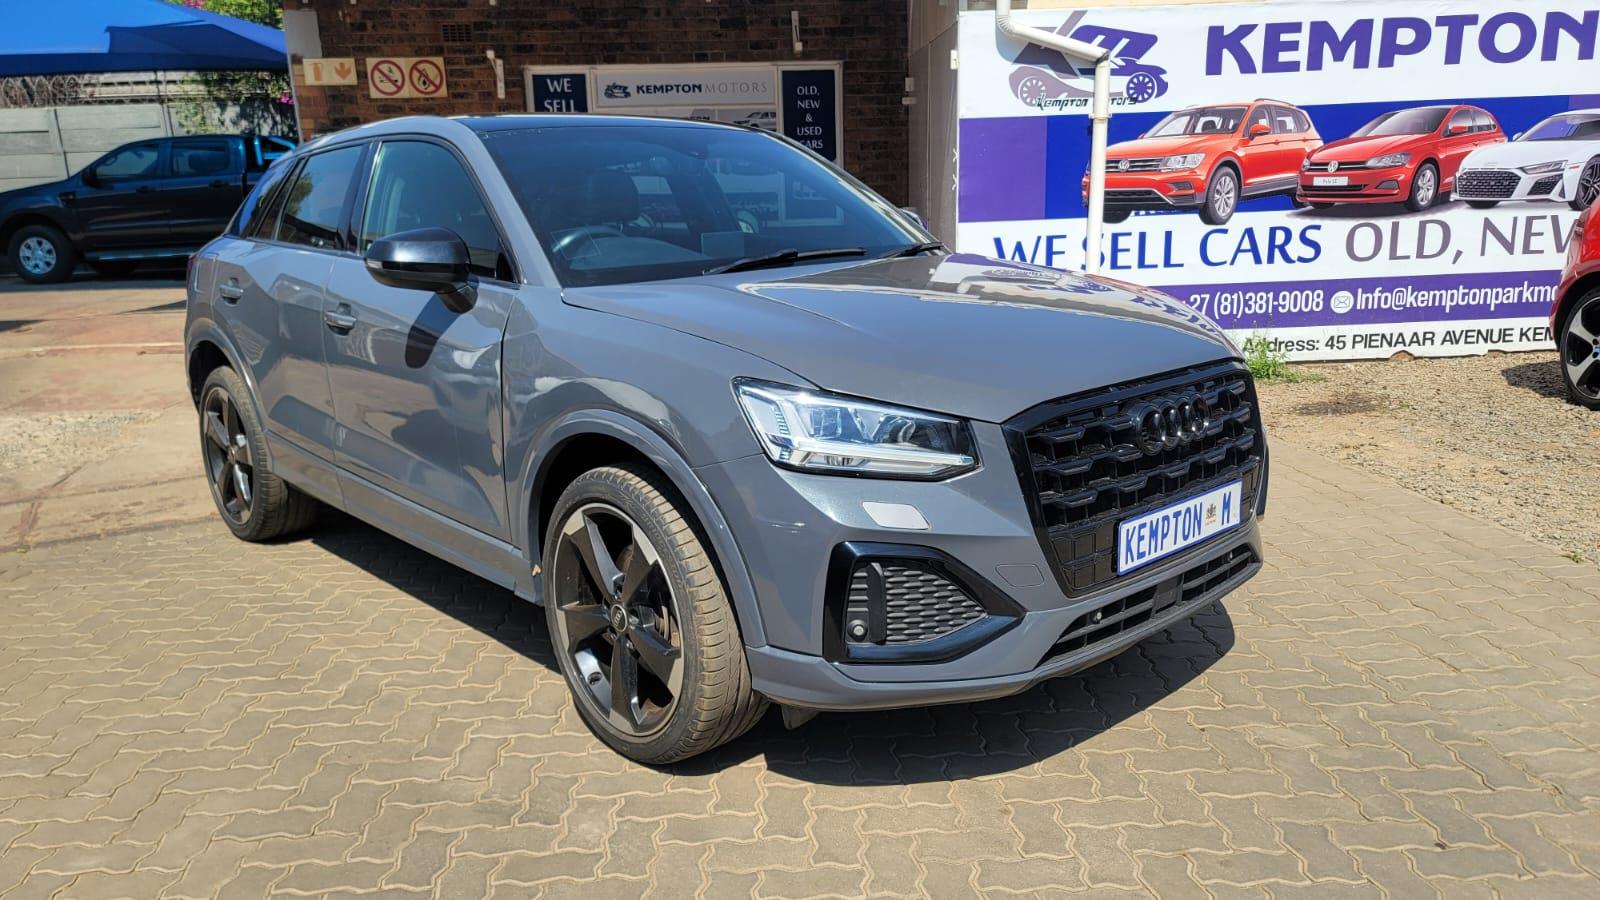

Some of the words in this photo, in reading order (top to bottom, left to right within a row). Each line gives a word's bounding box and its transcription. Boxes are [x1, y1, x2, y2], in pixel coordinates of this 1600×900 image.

[1205, 10, 1600, 76] KEMPTON
[546, 78, 573, 93] WE
[636, 83, 702, 94] KEMPTON
[705, 82, 768, 94] MOTORS
[796, 86, 820, 96] OLD,
[544, 99, 576, 112] SELL
[797, 99, 821, 109] NEW
[805, 113, 813, 122] &
[796, 126, 822, 136] USED
[993, 234, 1067, 267] WE
[1199, 224, 1323, 267] CARS
[1345, 219, 1464, 265] OLD,
[1182, 294, 1210, 315] 27
[1213, 289, 1324, 320] (81)381-9008
[1324, 334, 1347, 350] 45
[1351, 331, 1436, 349] PIENAAR
[1441, 328, 1515, 346] AVENUE
[1125, 502, 1203, 565] KEMPTON
[1221, 491, 1232, 526] M
